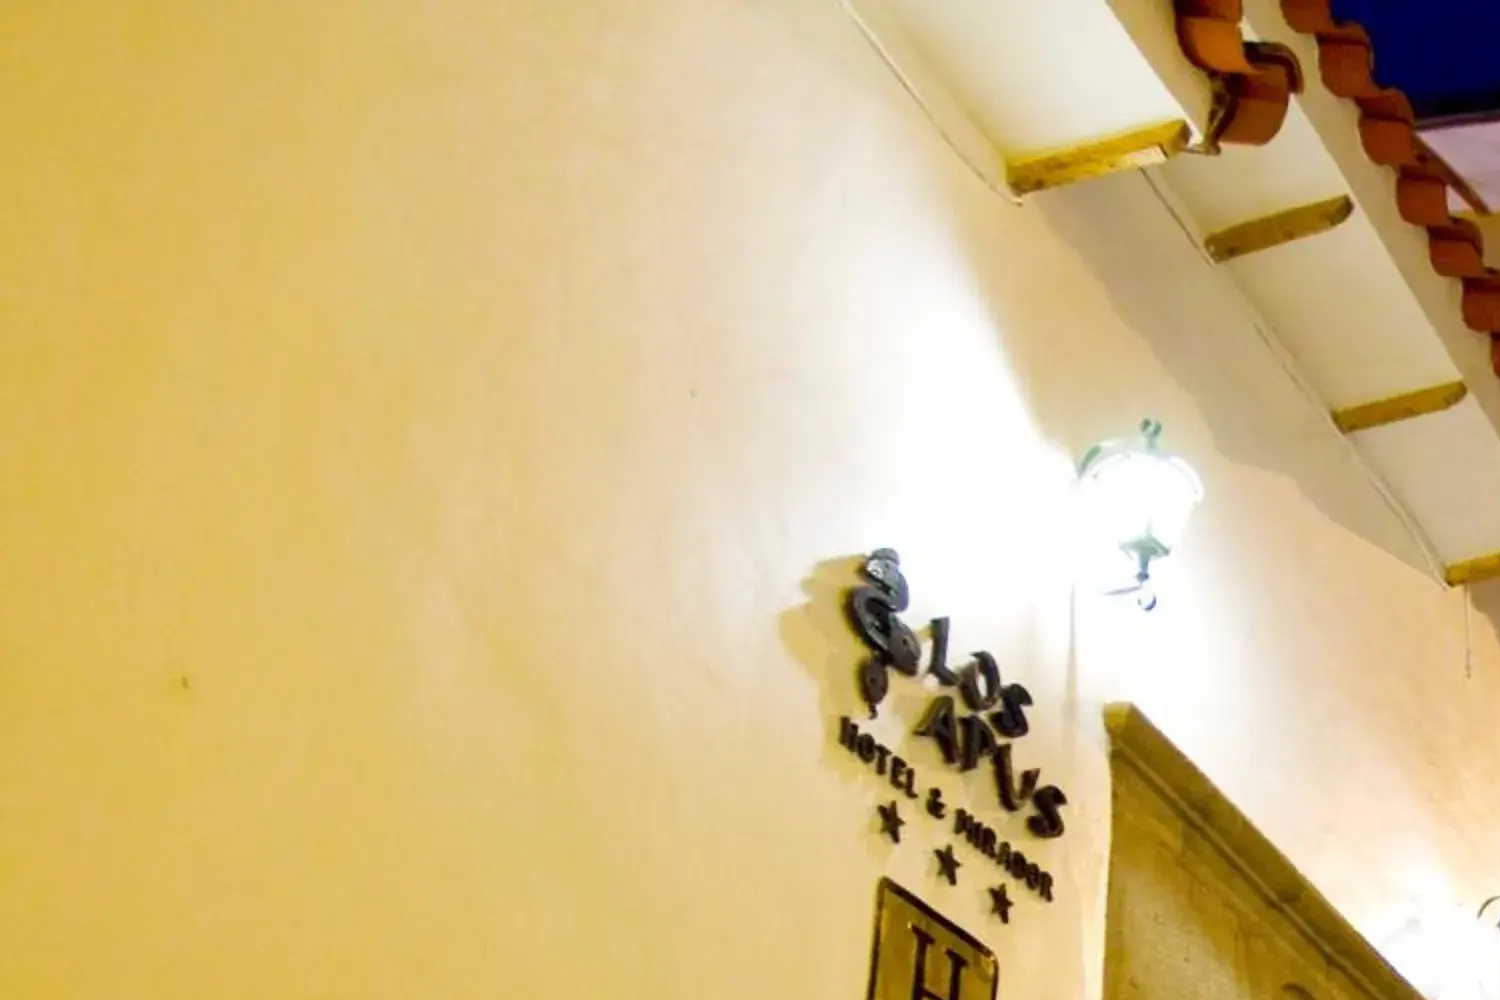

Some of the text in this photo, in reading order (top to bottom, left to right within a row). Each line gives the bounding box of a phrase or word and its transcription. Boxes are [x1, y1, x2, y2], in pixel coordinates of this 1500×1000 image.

[928, 616, 1033, 738] LOS
[839, 716, 918, 799] HOTEL
[954, 808, 1054, 902] MIRADOR
[914, 695, 1068, 838] APUS
